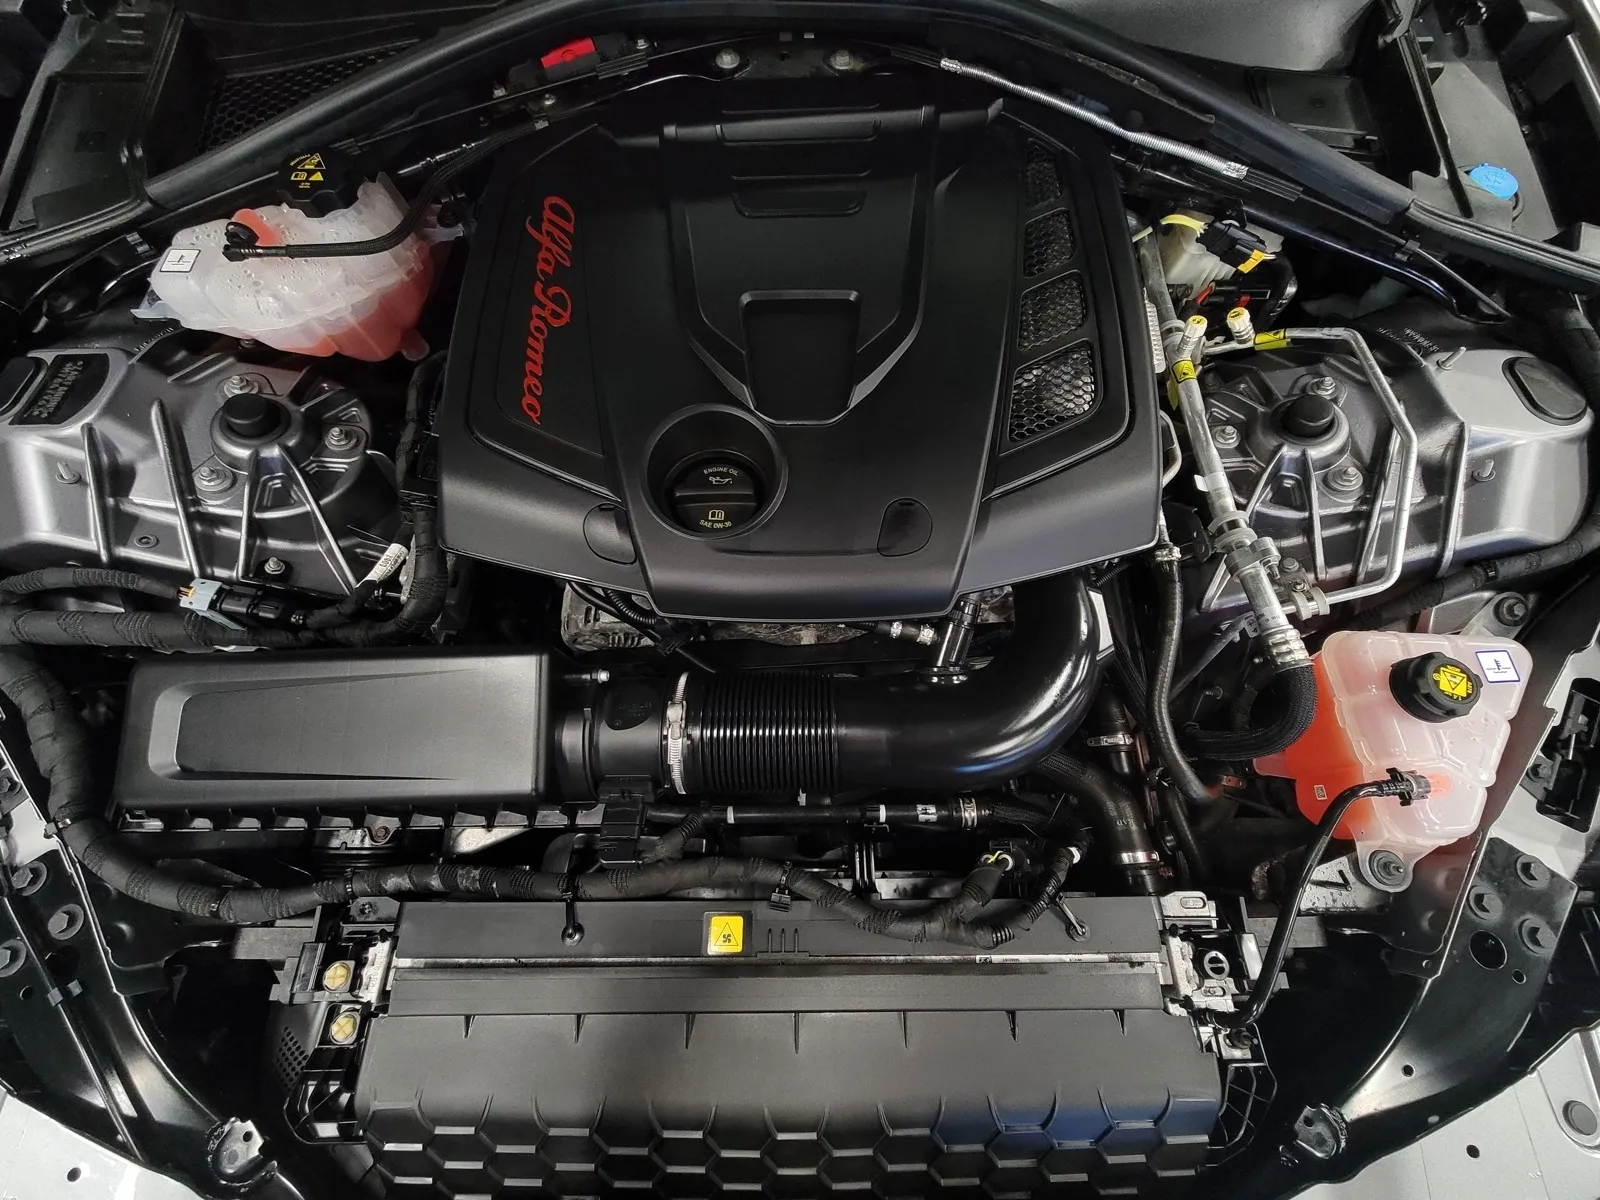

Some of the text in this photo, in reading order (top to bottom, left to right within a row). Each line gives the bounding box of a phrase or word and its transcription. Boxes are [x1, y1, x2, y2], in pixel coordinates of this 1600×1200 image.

[521, 195, 576, 425] Alfa Romeo
[703, 467, 739, 476] ENGINE OIL
[699, 519, 732, 529] SAE 0W-30
